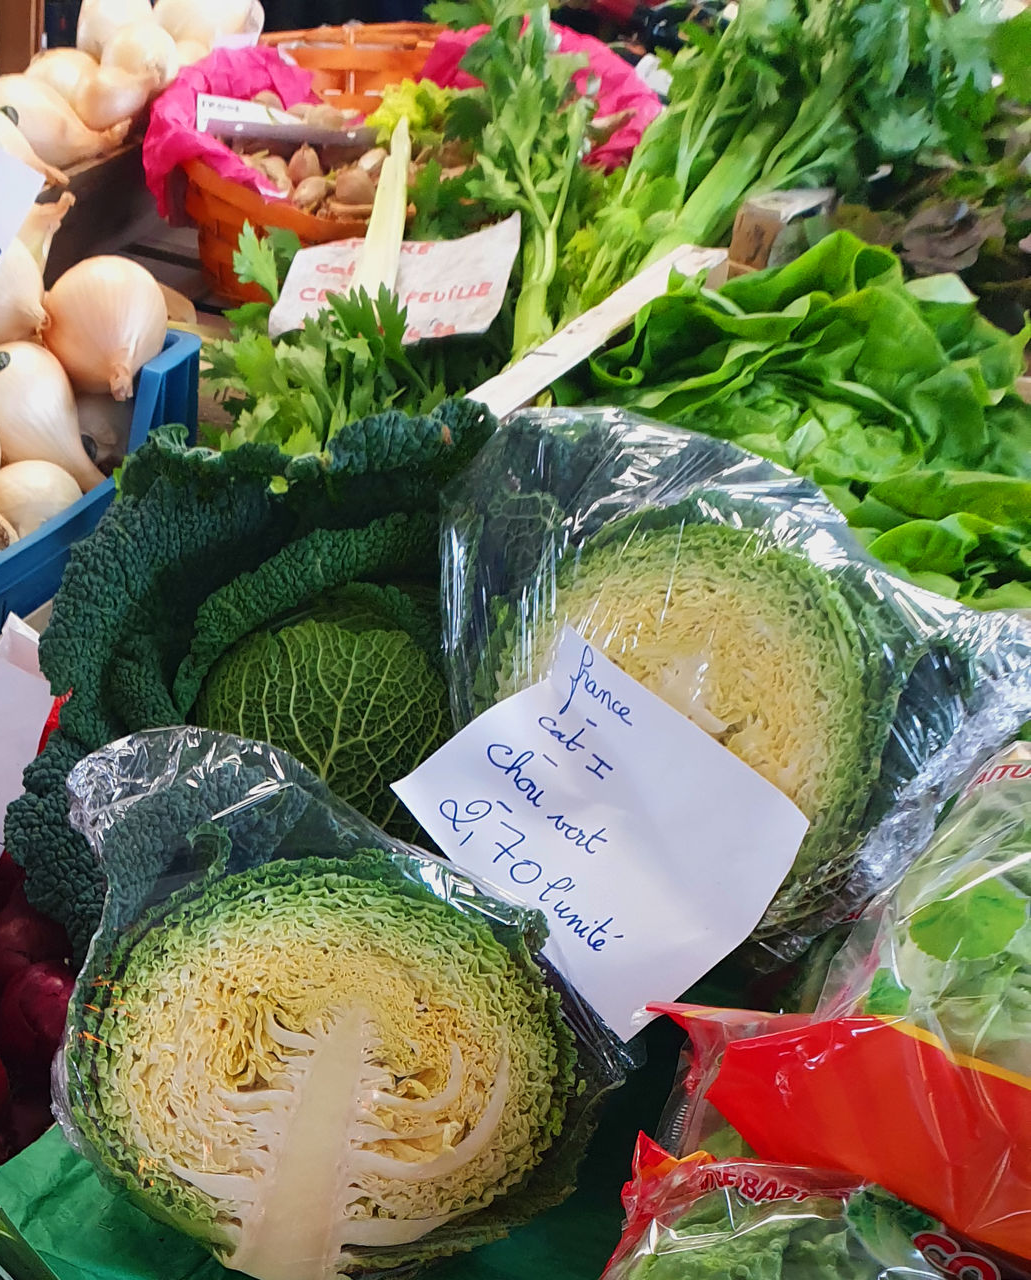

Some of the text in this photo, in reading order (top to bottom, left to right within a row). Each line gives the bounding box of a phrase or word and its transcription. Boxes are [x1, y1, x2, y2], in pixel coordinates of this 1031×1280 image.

[558, 645, 633, 726] france
[538, 716, 586, 752] cat
[546, 814, 608, 854] vert
[545, 876, 625, 952] l'unité
